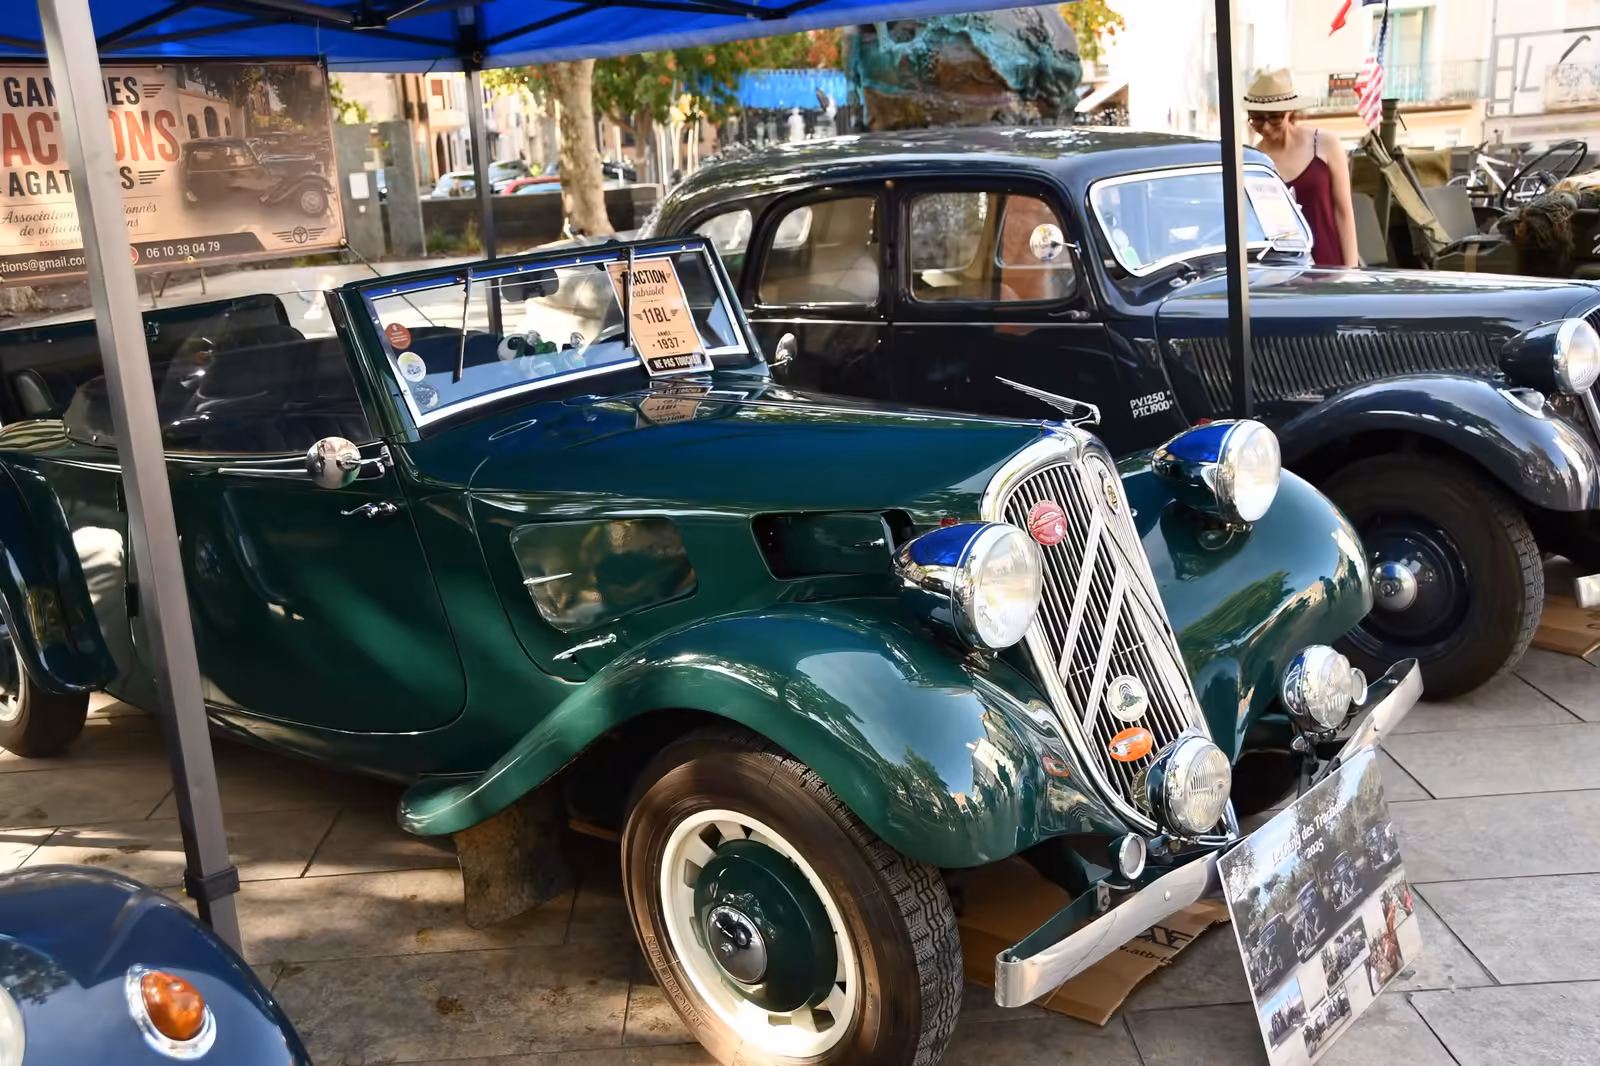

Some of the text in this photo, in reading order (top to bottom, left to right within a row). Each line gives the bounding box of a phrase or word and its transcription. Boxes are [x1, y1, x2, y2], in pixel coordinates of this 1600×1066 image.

[4, 77, 140, 107] GAN ES
[9, 166, 134, 197] AGATS
[1, 209, 74, 224] Association
[20, 225, 35, 236] de
[146, 241, 220, 258] 06 10 39 04 79
[621, 269, 668, 287] ACTION
[642, 307, 671, 324] 11BL
[657, 337, 680, 350] 1937
[653, 355, 702, 369] NE PAS TOUCHER
[1301, 824, 1315, 841] des
